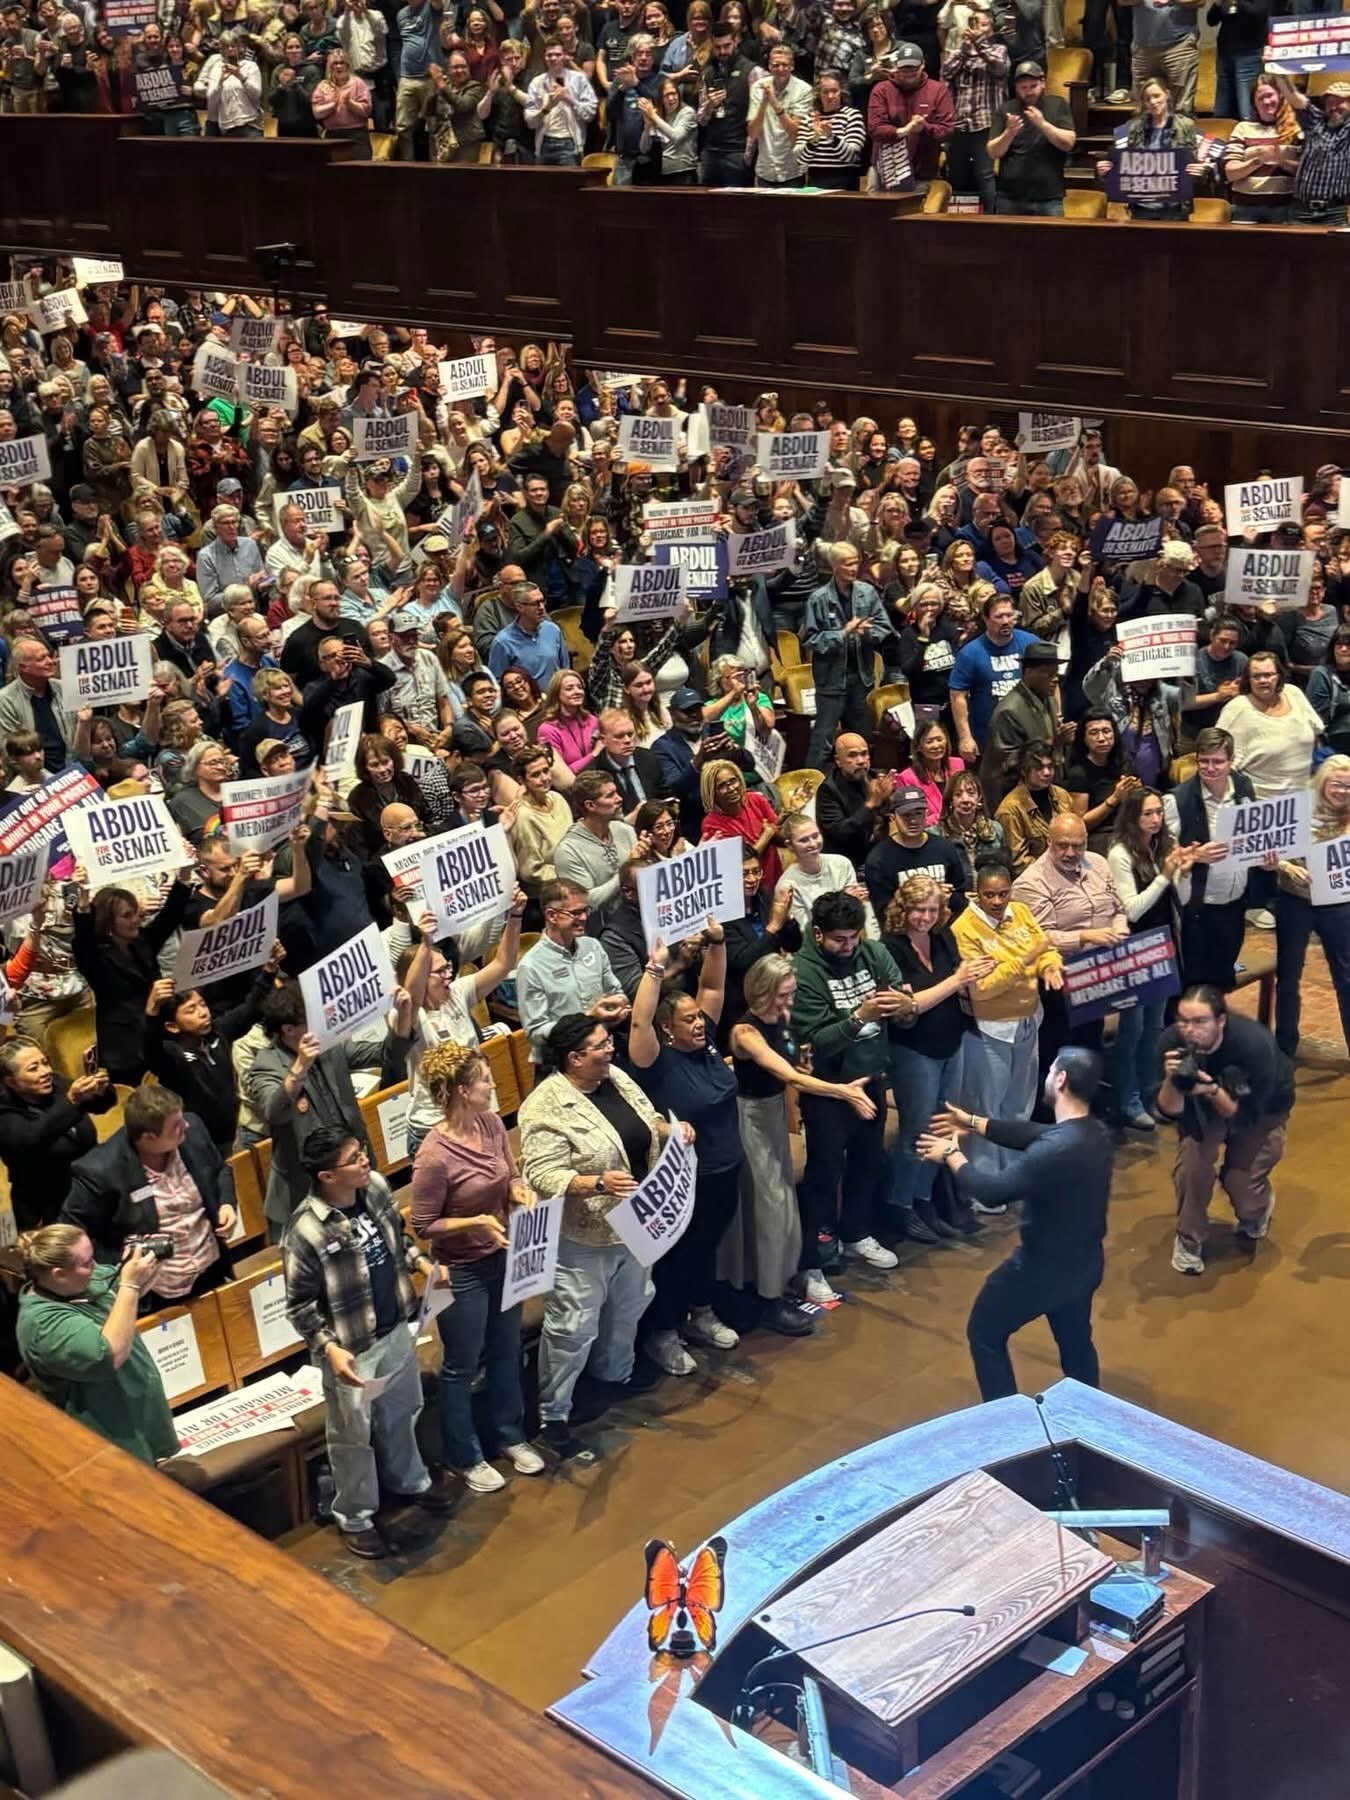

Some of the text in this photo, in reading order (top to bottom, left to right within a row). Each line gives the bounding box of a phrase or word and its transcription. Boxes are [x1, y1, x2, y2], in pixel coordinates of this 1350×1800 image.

[136, 69, 176, 90] ABDUL
[1119, 151, 1178, 175] ABDUL
[1130, 175, 1178, 192] SENATE
[246, 366, 287, 388] ABDUL
[449, 358, 487, 380] ABDUL
[460, 375, 488, 391] SENATE
[365, 417, 410, 438] ABDUL
[631, 419, 674, 440] ABDUL
[375, 436, 409, 451] SENATE
[770, 435, 819, 456] ABDUL
[288, 490, 332, 511] ABDUL
[1240, 481, 1293, 508] ABDUL
[306, 510, 333, 525] ENATE
[1252, 503, 1292, 522] SENATE
[739, 529, 787, 553] ABDUL
[1105, 518, 1161, 541] ABDUL
[669, 546, 719, 570] ABDUL
[1243, 553, 1301, 577] ABDUL
[630, 567, 681, 593] ABDUL
[688, 571, 718, 588] ENATE
[639, 591, 679, 609] SENATE
[77, 641, 138, 675] ABDUL
[92, 668, 139, 694] SENATE
[0, 811, 20, 836] ONEY
[19, 797, 38, 815] OUT
[35, 789, 48, 803] OF
[46, 769, 84, 793] POLITICS
[27, 814, 39, 828] IN
[87, 800, 164, 843] ABDUL
[1232, 798, 1299, 836] ABDUL
[98, 852, 113, 866] US
[112, 831, 171, 863] SENATE
[1245, 826, 1297, 853] SENATE
[436, 836, 498, 892] ABDUL
[656, 846, 723, 902] ABDUL
[455, 870, 504, 912] SENATE
[1329, 878, 1344, 890] US
[658, 912, 673, 928] US
[674, 882, 724, 924] SENATE
[195, 905, 266, 958] ABDUL
[207, 935, 265, 972] SENATE
[317, 939, 378, 1005] ABDUL
[1071, 960, 1172, 1006] MEDICARE FOR ALL
[336, 973, 385, 1022] SENATE
[630, 1136, 685, 1226] ABDUL
[513, 1206, 549, 1254] ABDUL
[229, 1385, 295, 1412] MEDICARE
[201, 1411, 229, 1426] FOR
